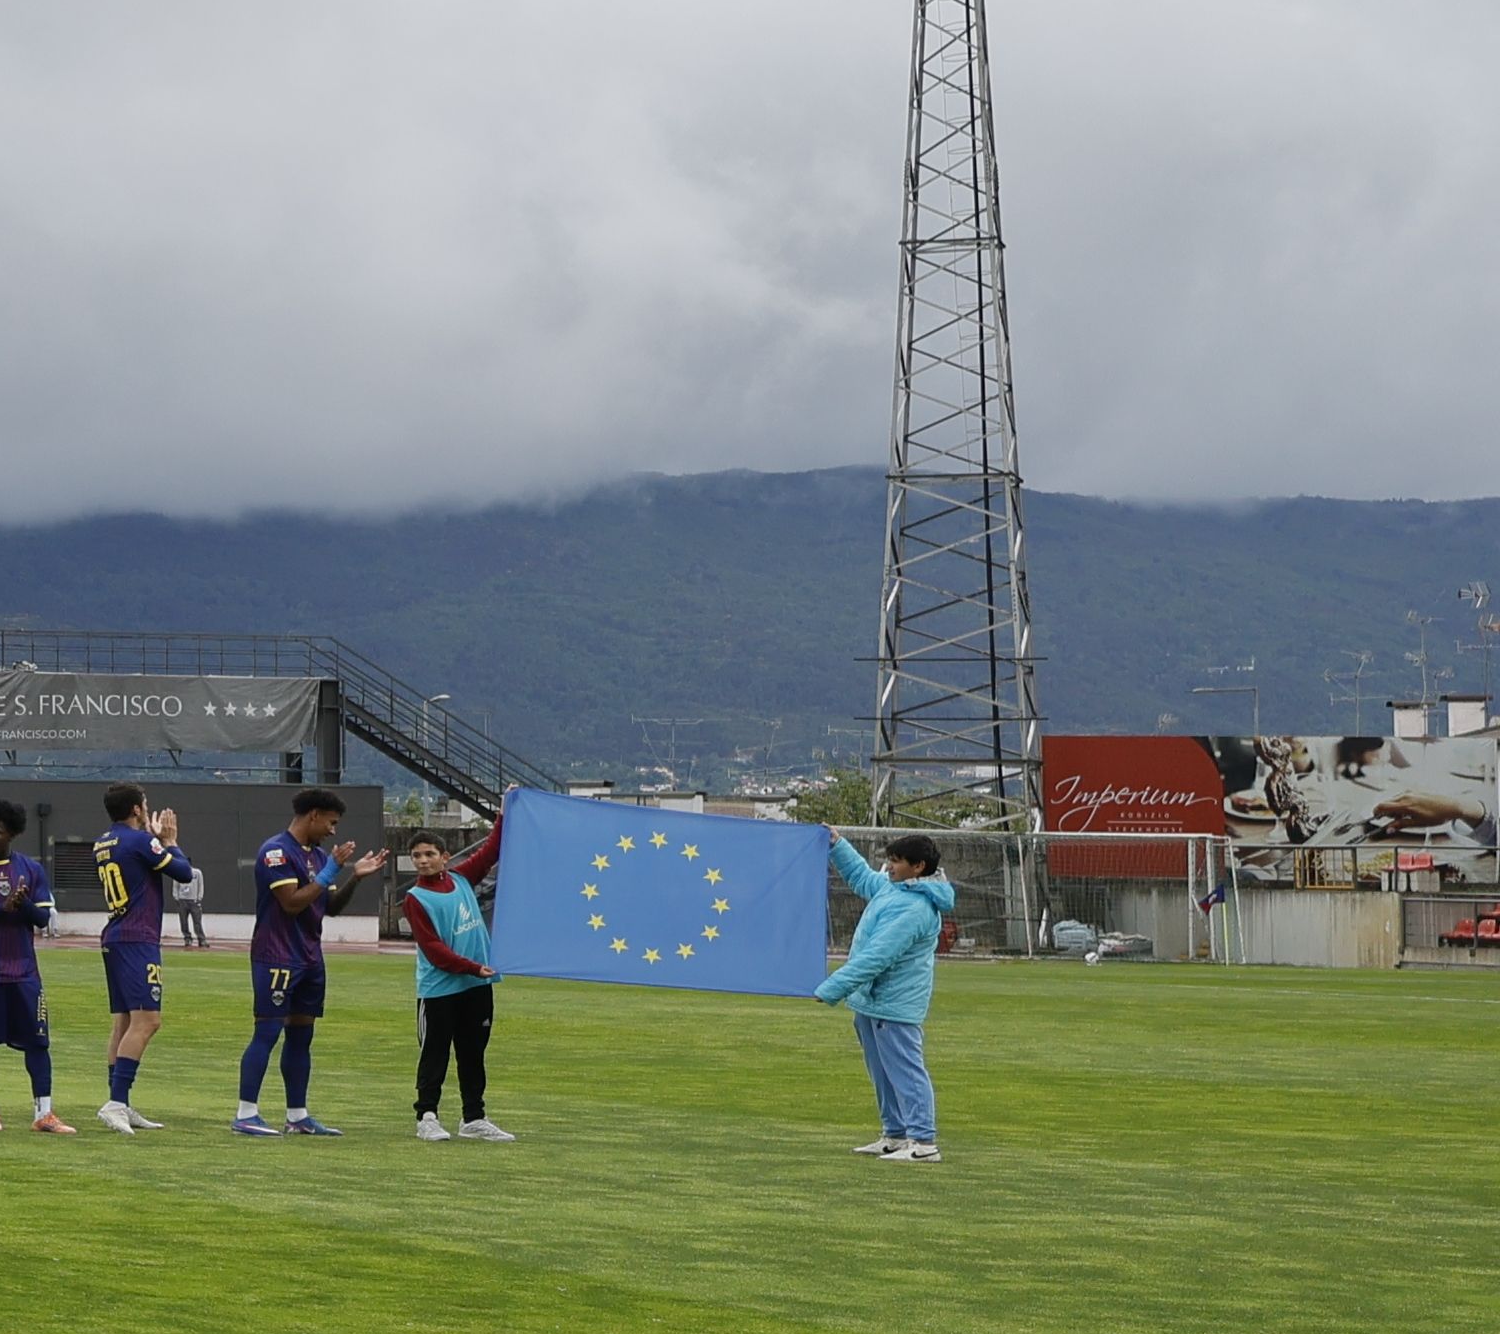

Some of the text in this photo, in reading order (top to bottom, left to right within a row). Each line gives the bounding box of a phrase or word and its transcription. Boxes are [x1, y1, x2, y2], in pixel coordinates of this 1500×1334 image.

[14, 695, 33, 716] S.
[39, 694, 183, 717] FRANCISCO
[1051, 775, 1217, 833] Imperium
[98, 862, 129, 910] 20
[146, 963, 162, 984] 20
[269, 968, 291, 990] 77
